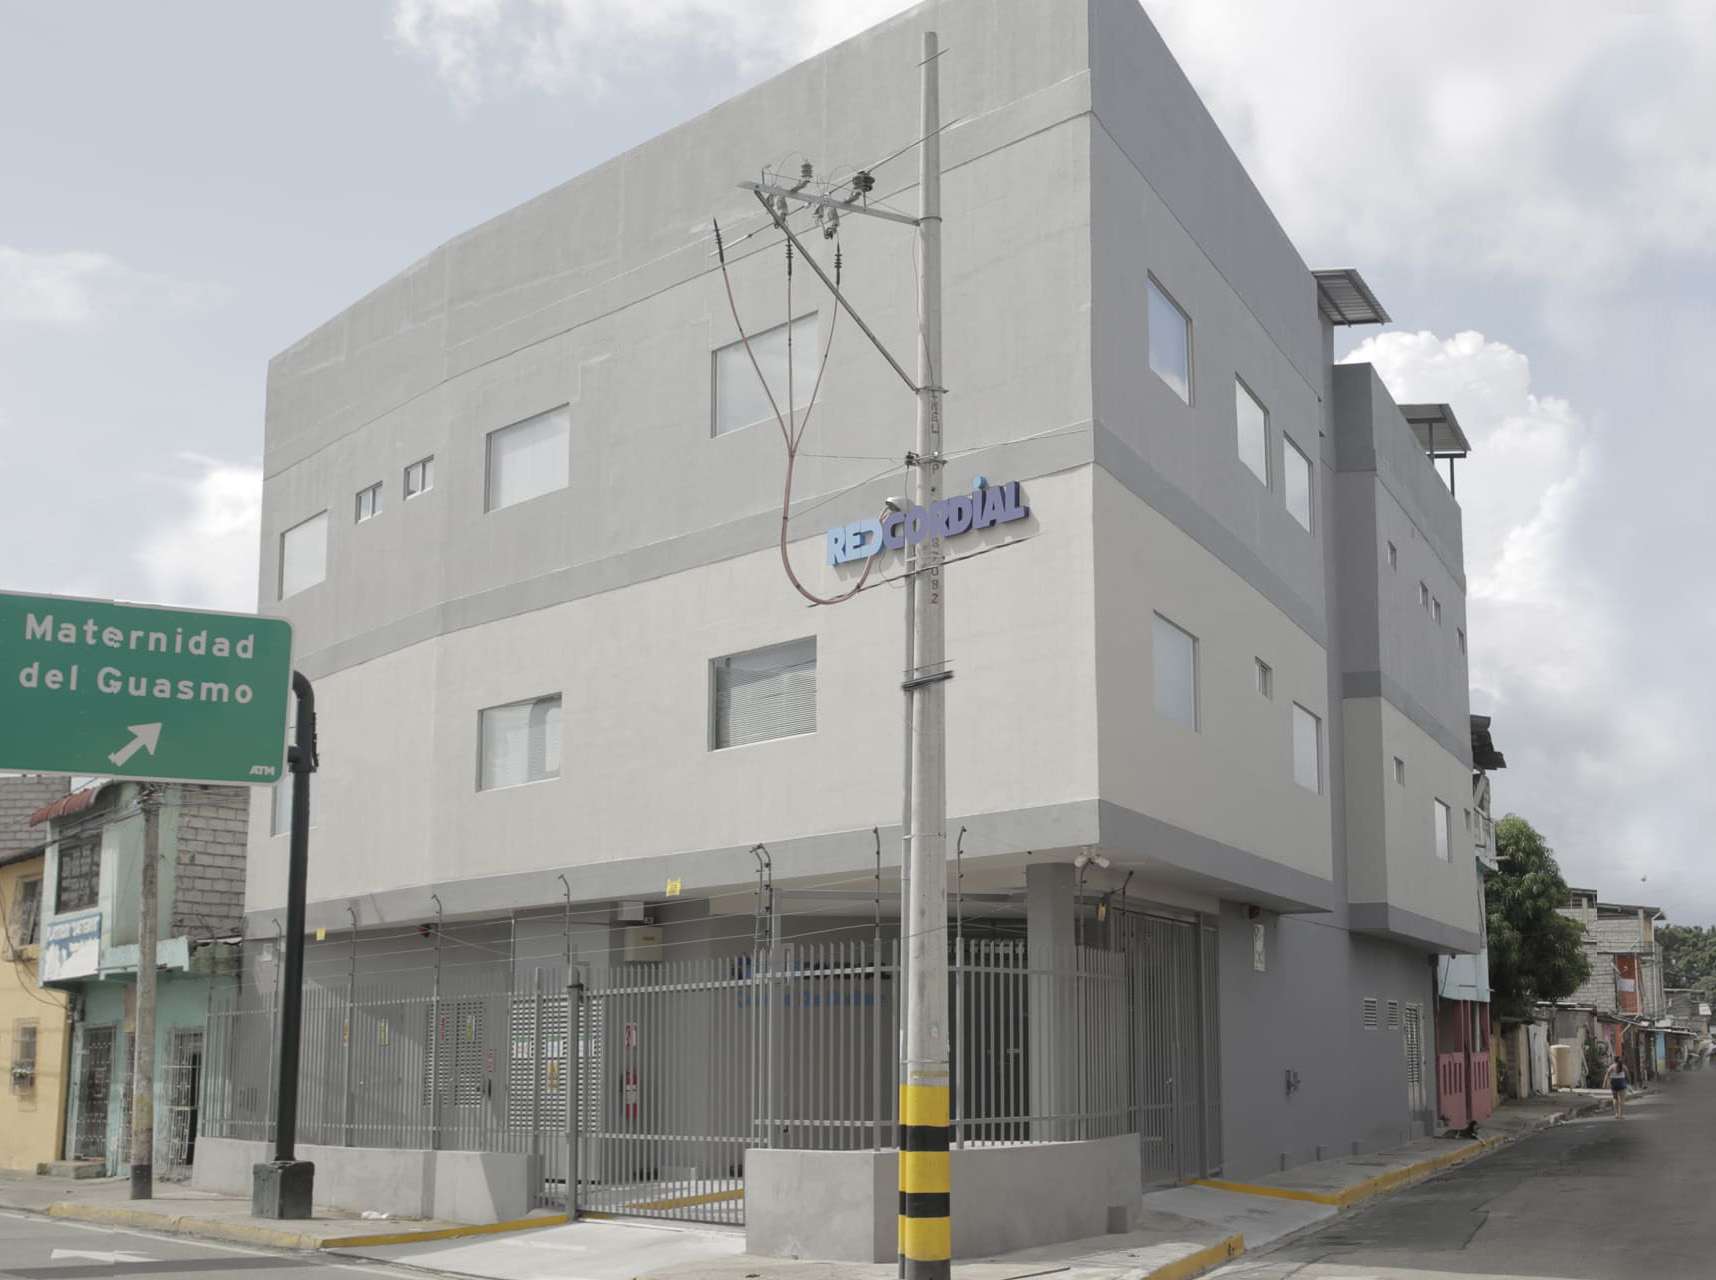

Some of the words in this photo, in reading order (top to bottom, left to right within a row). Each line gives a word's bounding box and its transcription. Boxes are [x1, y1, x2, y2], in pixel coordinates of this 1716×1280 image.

[25, 613, 255, 660] Maternidad
[19, 662, 78, 691] del
[97, 666, 253, 704] Guasmo
[249, 765, 275, 777] ATM
